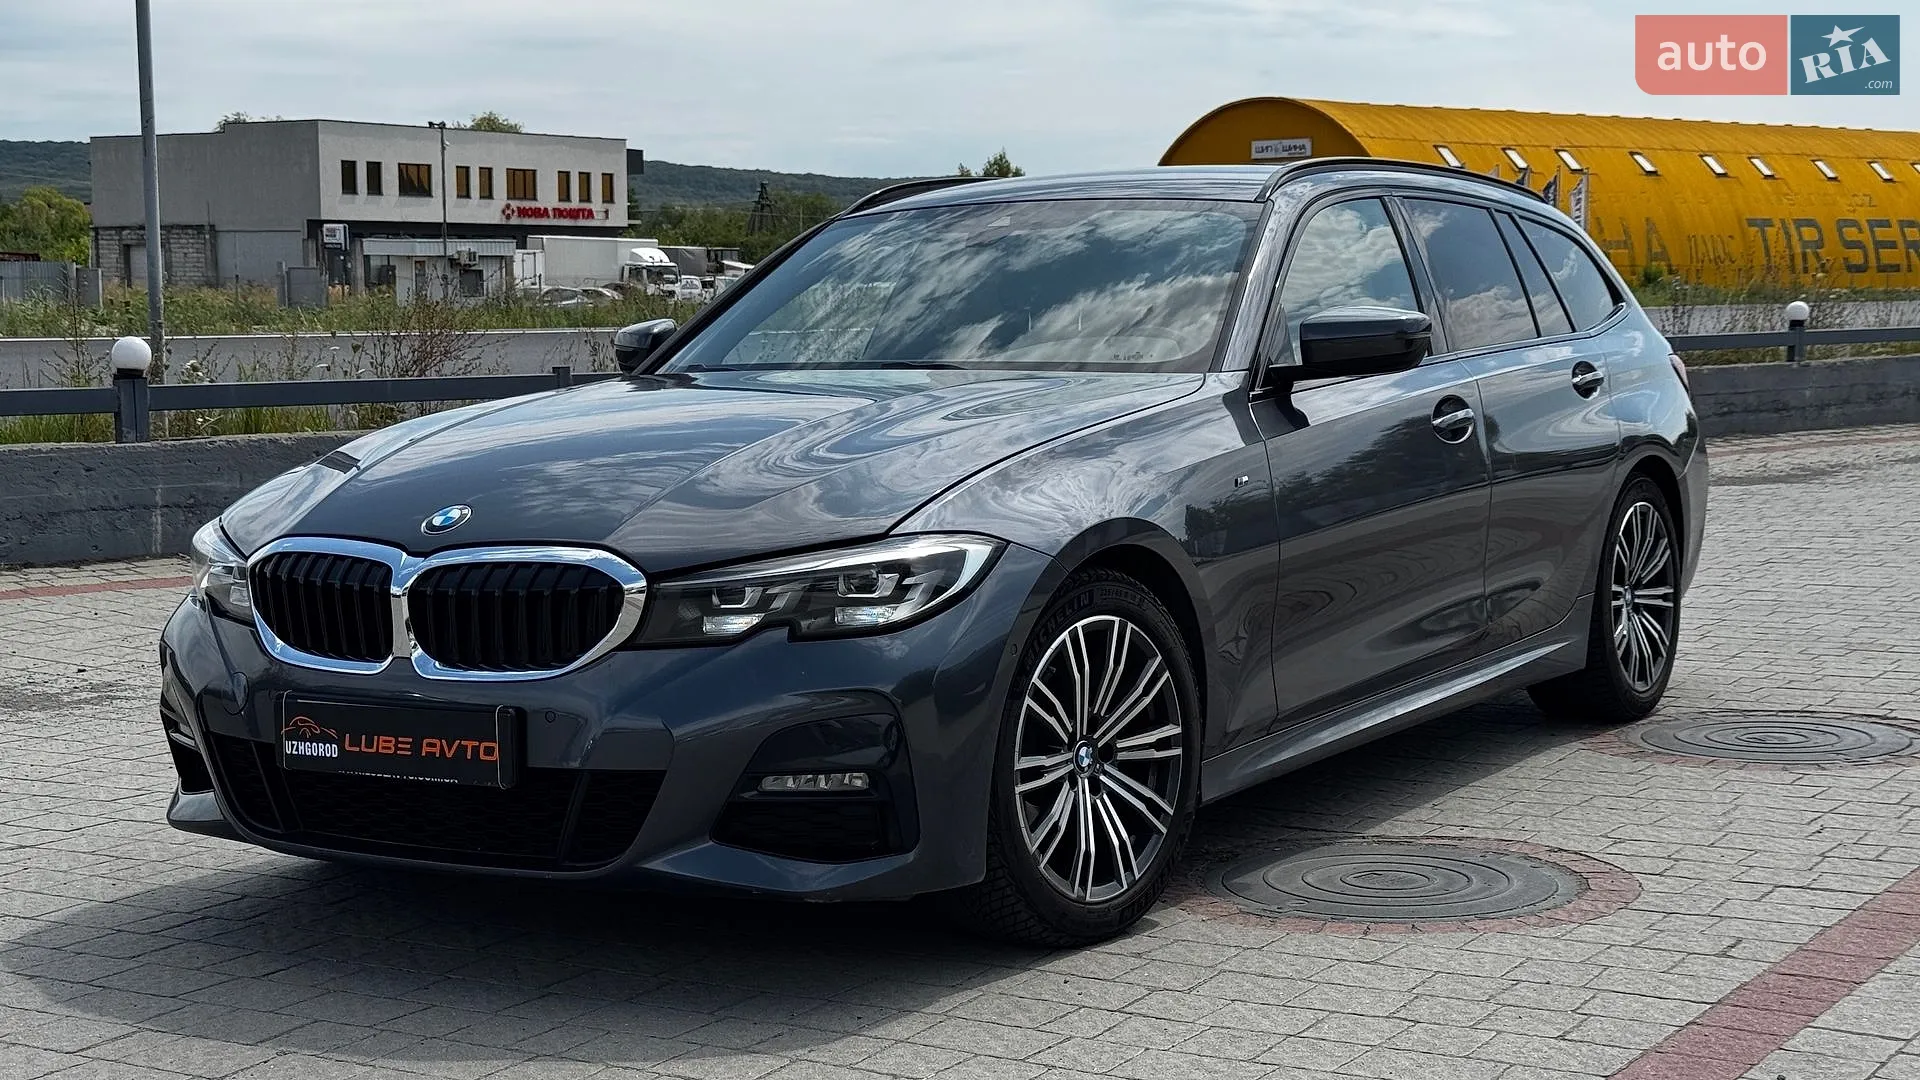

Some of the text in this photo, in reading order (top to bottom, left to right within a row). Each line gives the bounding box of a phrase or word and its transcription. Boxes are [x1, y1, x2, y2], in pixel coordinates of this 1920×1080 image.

[516, 206, 549, 219] НОВА
[552, 207, 595, 220] ПОШТА
[1745, 217, 1826, 275] TIR
[285, 739, 339, 759] UZHGOROD
[344, 733, 498, 761] LUBE AVTO
